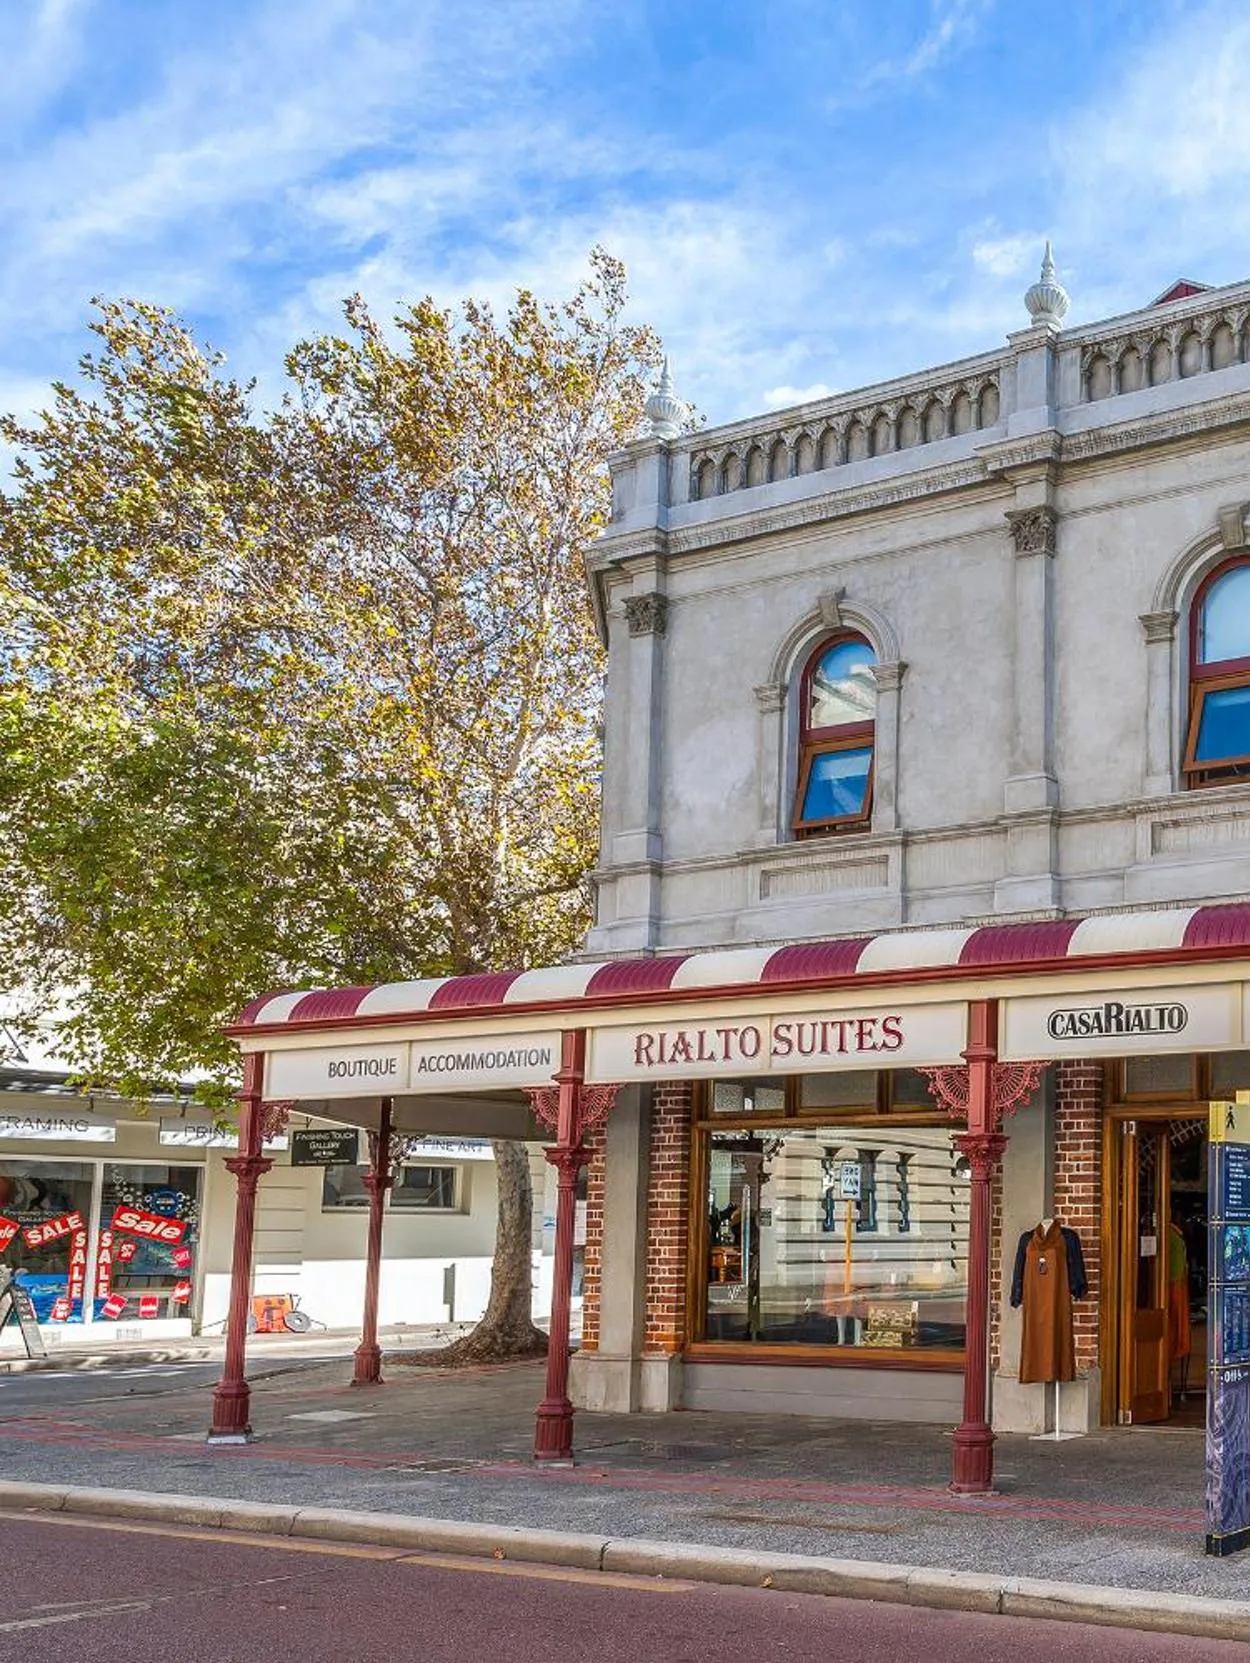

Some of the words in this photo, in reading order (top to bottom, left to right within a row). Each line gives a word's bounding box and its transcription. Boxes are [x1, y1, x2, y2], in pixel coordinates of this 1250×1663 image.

[634, 1025, 762, 1067] RIALTO
[770, 1015, 905, 1057] SUITES
[328, 1058, 397, 1078] BOUTIQUE
[418, 1048, 551, 1073] ACCOMMODATION
[26, 1214, 83, 1244] SALE
[114, 1211, 182, 1240] Sale
[71, 1231, 87, 1298] SALE
[97, 1231, 113, 1298] SALE
